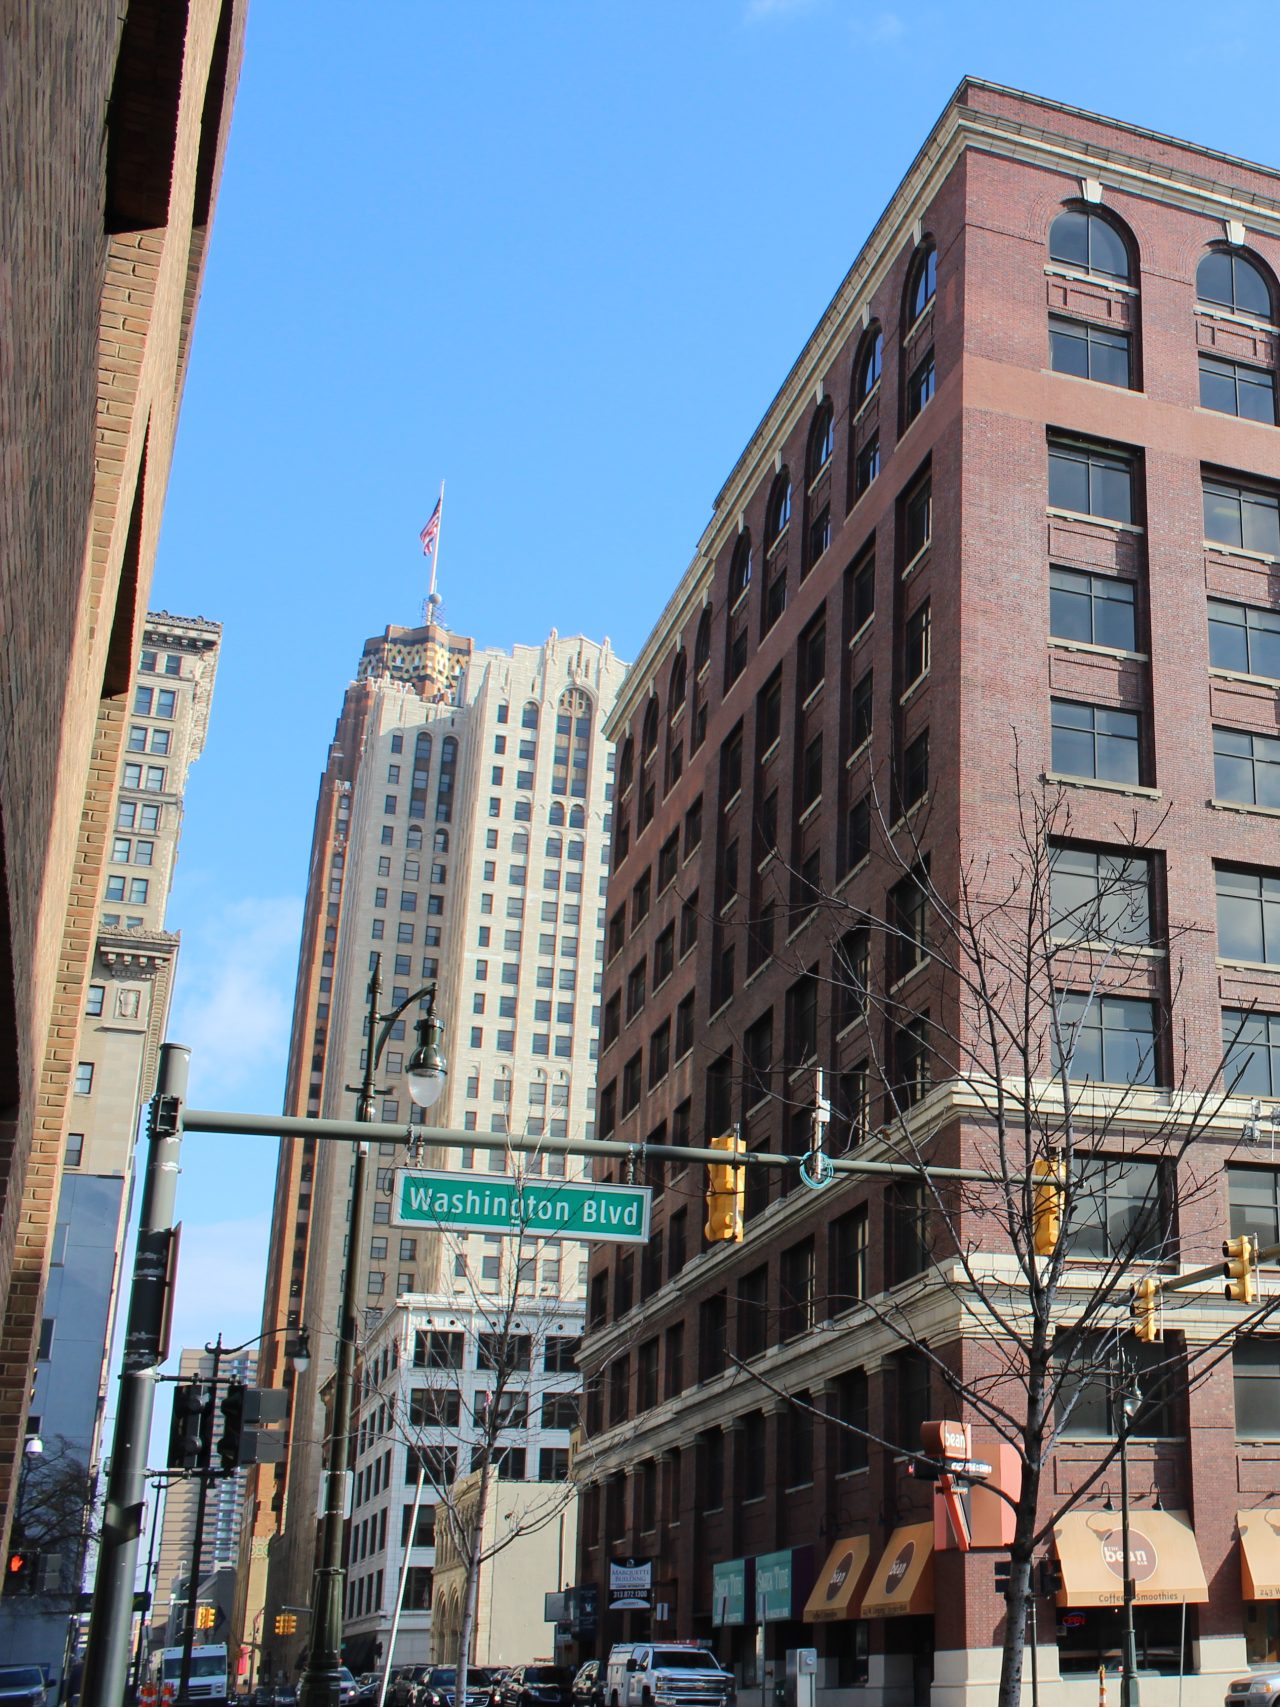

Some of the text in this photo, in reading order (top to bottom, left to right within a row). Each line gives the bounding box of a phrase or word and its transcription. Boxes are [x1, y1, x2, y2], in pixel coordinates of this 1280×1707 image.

[409, 1186, 638, 1226] Washington Blvd
[945, 1428, 965, 1448] bean
[1135, 1592, 1178, 1601] Smoothies
[1260, 1589, 1273, 1597] 243
